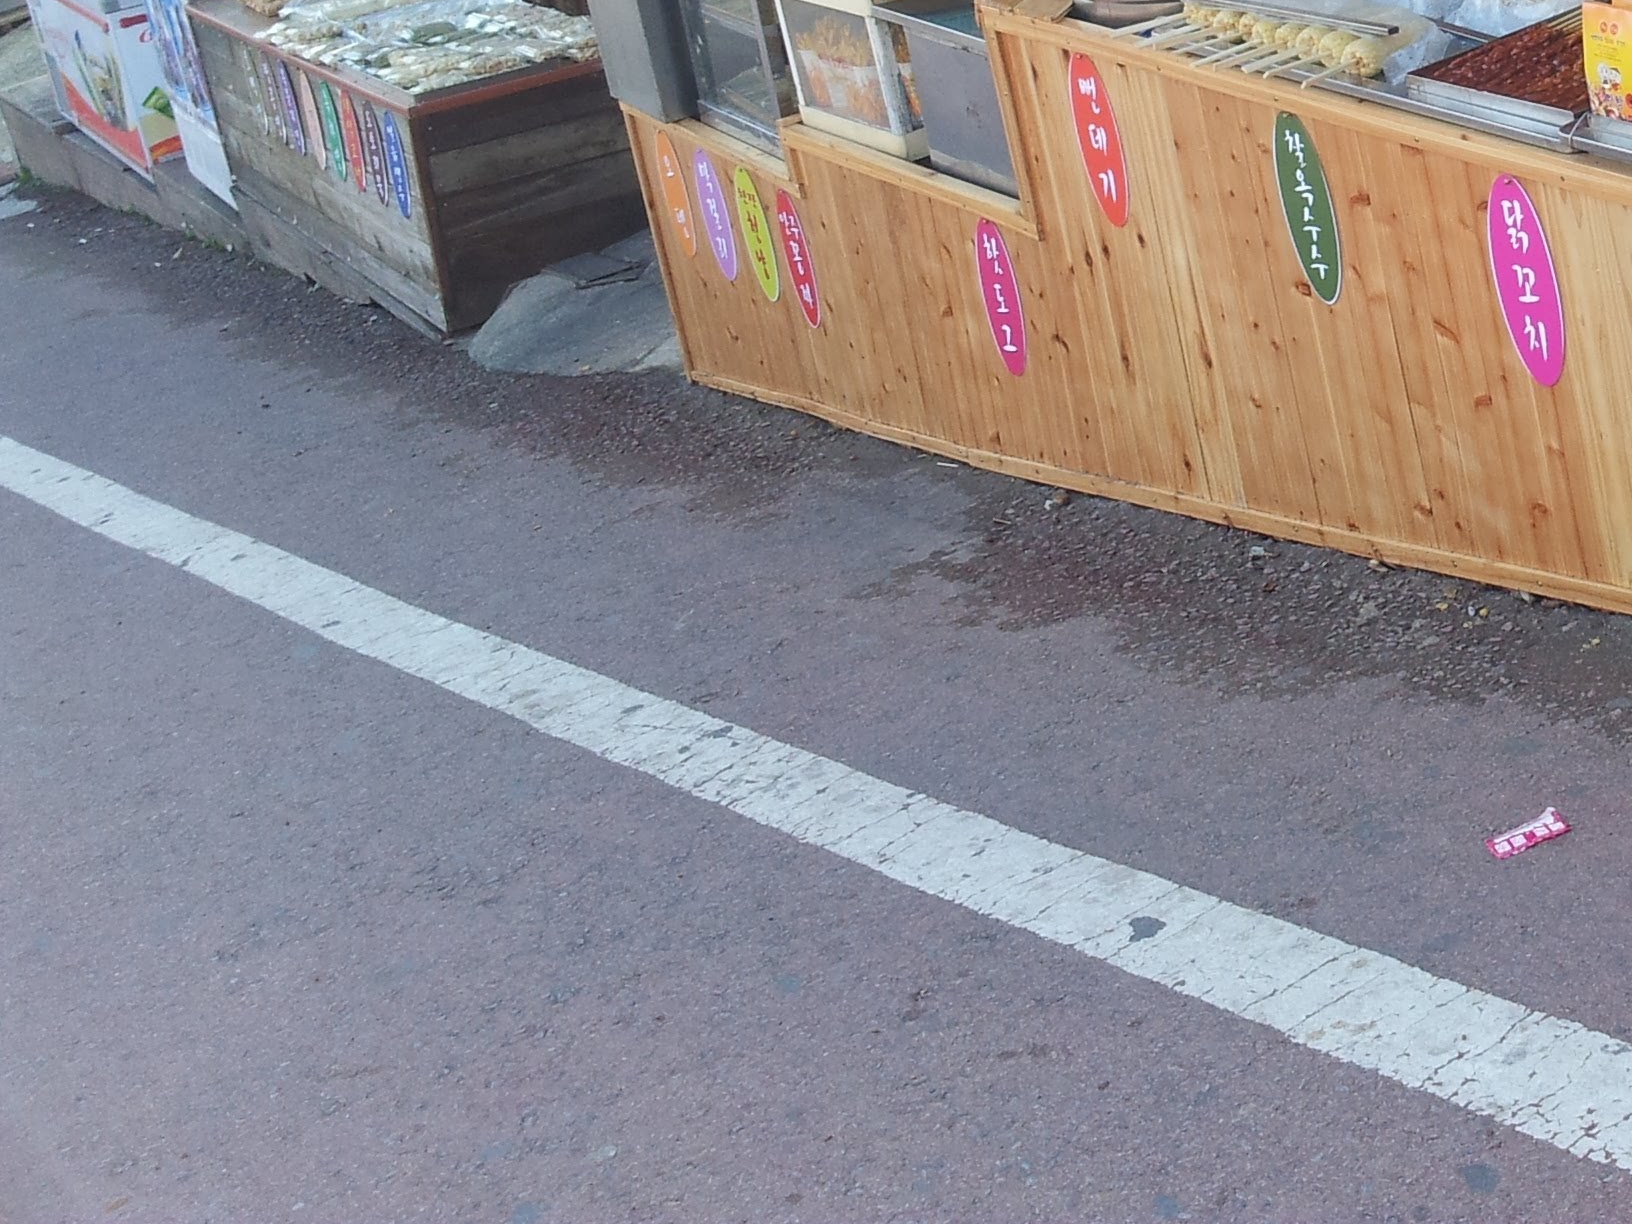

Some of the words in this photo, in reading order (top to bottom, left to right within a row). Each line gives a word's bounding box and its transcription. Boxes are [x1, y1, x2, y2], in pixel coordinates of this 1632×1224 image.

[1077, 77, 1117, 203] 번데기
[1284, 129, 1329, 279] 찰옥수수
[698, 162, 728, 259] 막걸리
[1501, 199, 1548, 362] 닭꼬치
